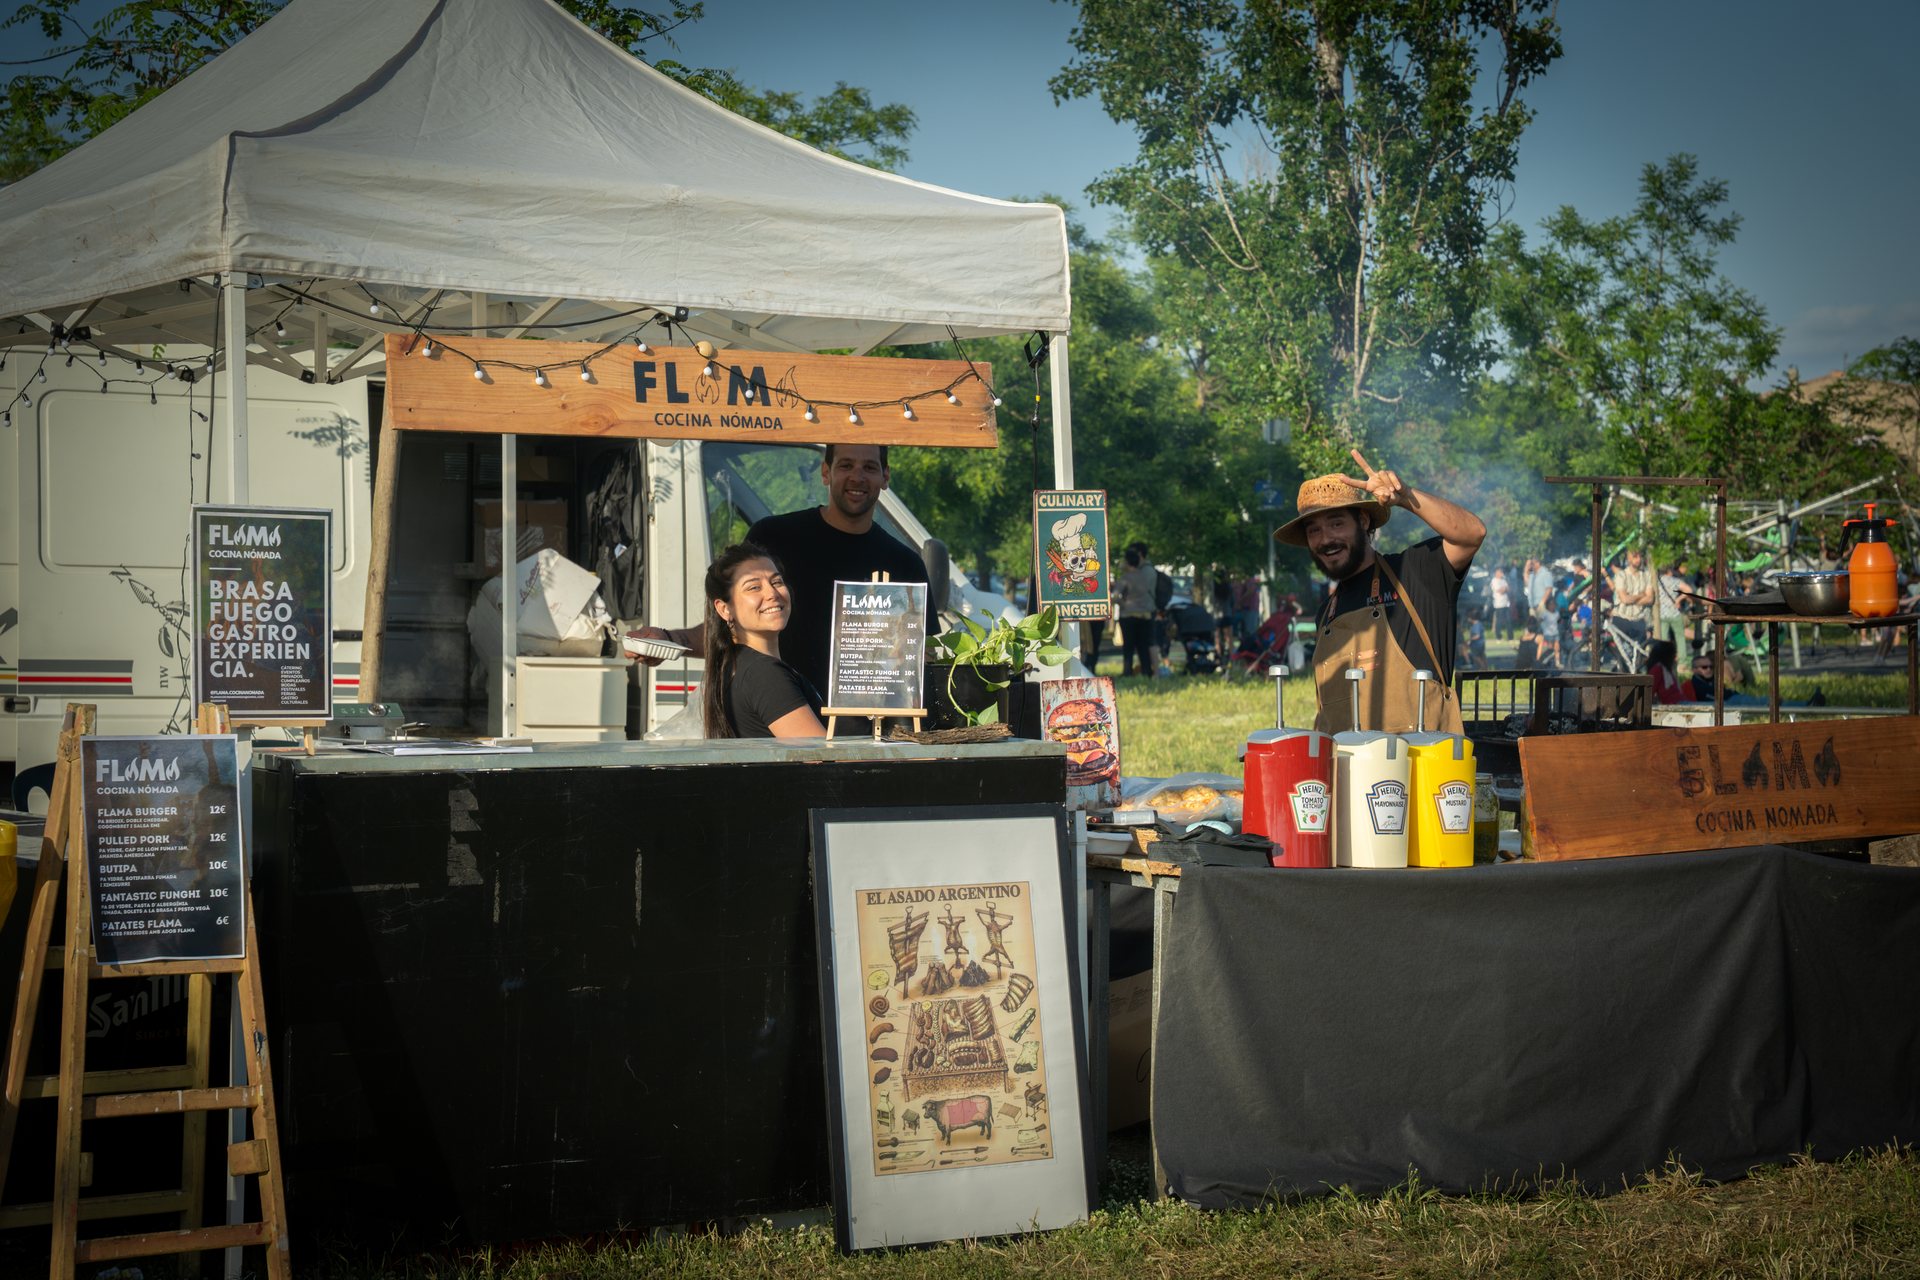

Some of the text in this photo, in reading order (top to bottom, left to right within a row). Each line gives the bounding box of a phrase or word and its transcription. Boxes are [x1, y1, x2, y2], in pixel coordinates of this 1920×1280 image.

[654, 412, 783, 430] COCINA NÓMADA
[1039, 494, 1102, 507] CULINARY
[209, 548, 281, 559] COCINA NÓMADA
[210, 580, 293, 600] BRASA
[210, 602, 292, 622] FUEGO
[210, 624, 297, 641] GASTRO
[210, 642, 310, 660] EXPERIEN
[210, 660, 254, 678] CIA.
[97, 784, 178, 794] COCINA NÓMADA
[1302, 786, 1322, 794] HEINZ
[1380, 788, 1400, 796] HEINZ
[1446, 788, 1466, 796] HEINZ
[98, 805, 226, 816] FLAMA BURGER 12€
[1695, 803, 1838, 834] COCINA NOMADA
[99, 833, 226, 845] PULLED PORK 12€
[100, 860, 228, 873] BUTIPA 10€
[101, 888, 228, 902] FANTASTIC FUNGHI 10€
[866, 884, 1020, 906] EL ASADO ARGENTINO
[102, 916, 230, 930] PATATES FLAMA 6€
